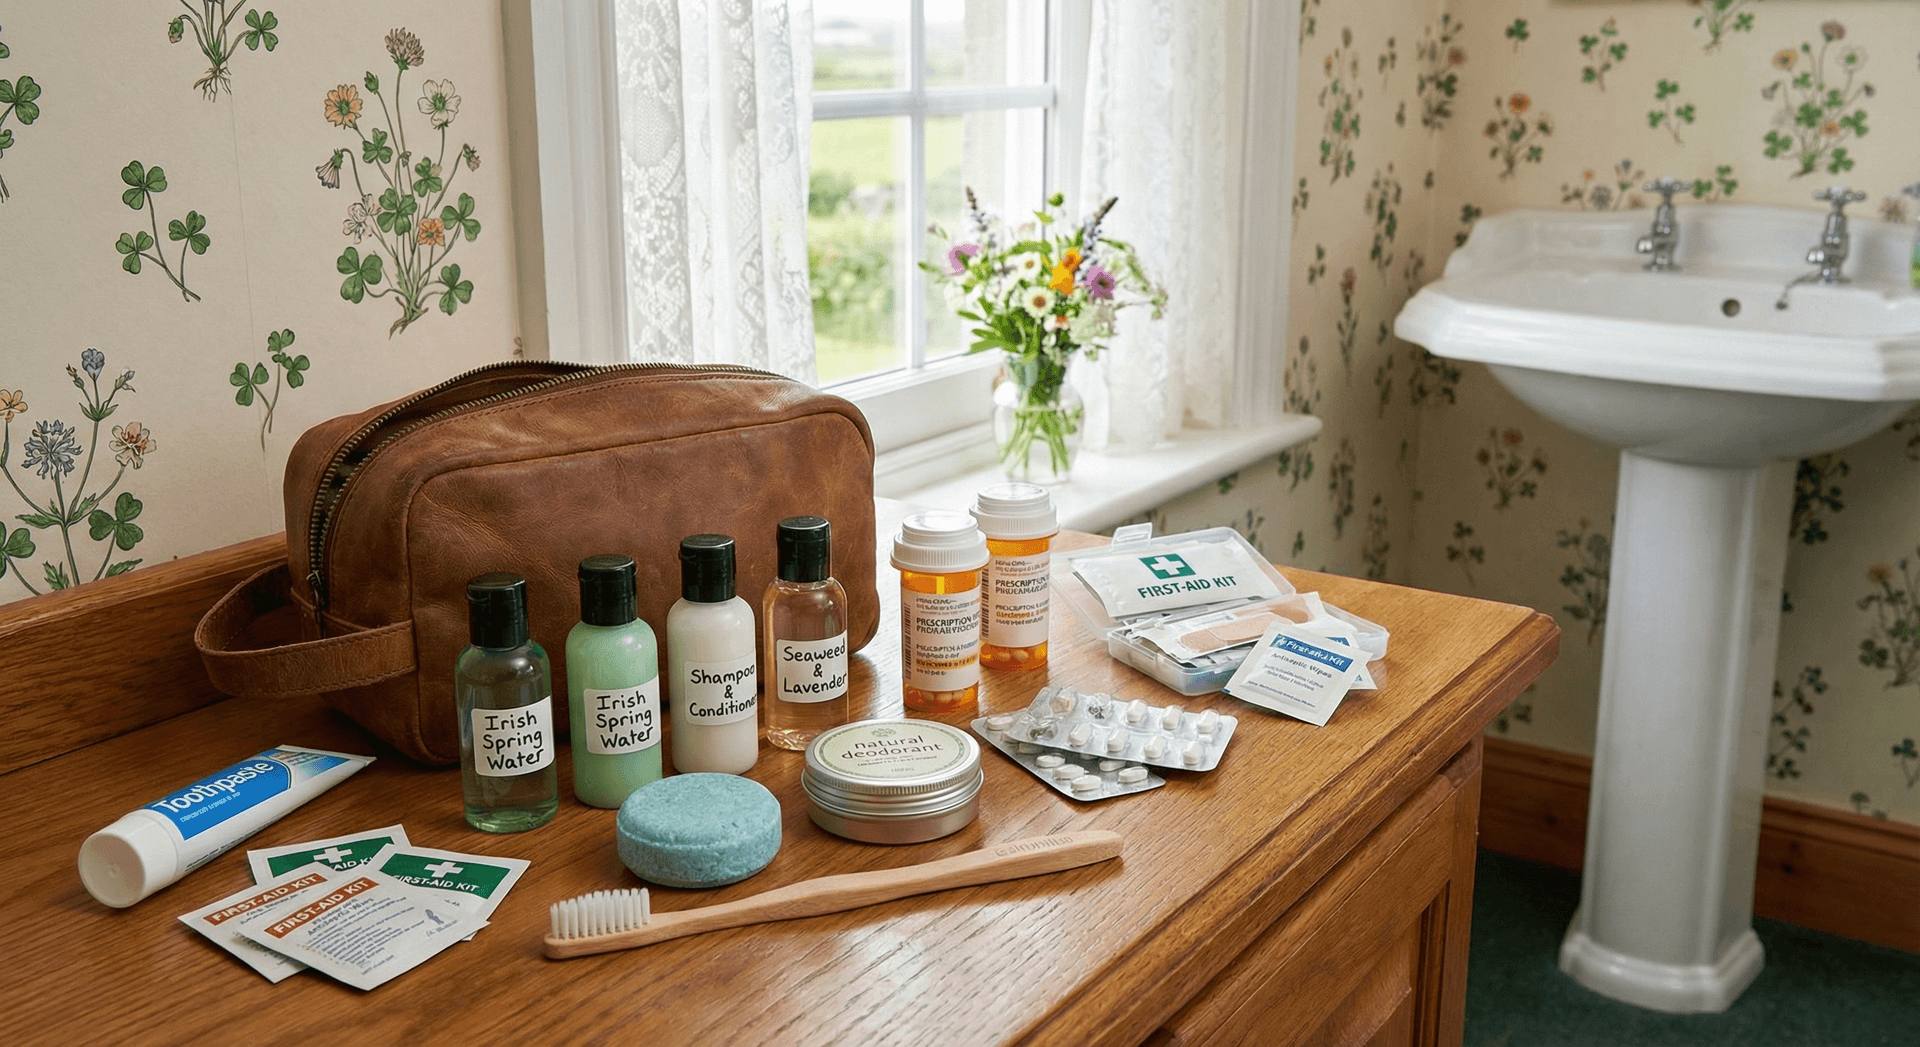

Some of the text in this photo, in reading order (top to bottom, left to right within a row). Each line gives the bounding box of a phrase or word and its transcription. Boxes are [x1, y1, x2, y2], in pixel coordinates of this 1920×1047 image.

[1137, 576, 1237, 598] FIRST-AID KIT
[783, 637, 846, 662] Seaweed
[690, 665, 755, 685] Shampoo
[813, 663, 823, 678] &
[724, 684, 733, 699] &
[783, 673, 847, 694] Lavender
[597, 690, 646, 710] Irish
[484, 710, 537, 730] Irish
[596, 709, 652, 733] Spring
[483, 731, 542, 754] Spring
[600, 726, 653, 748] Water
[854, 735, 924, 749] natural
[487, 749, 544, 770] Water
[841, 743, 943, 759] deodorant
[151, 762, 274, 813] Toothpaste
[291, 875, 318, 889] KIT
[455, 882, 480, 892] KIT
[273, 893, 345, 933] FIRST-AID
[343, 880, 369, 894] KIT
